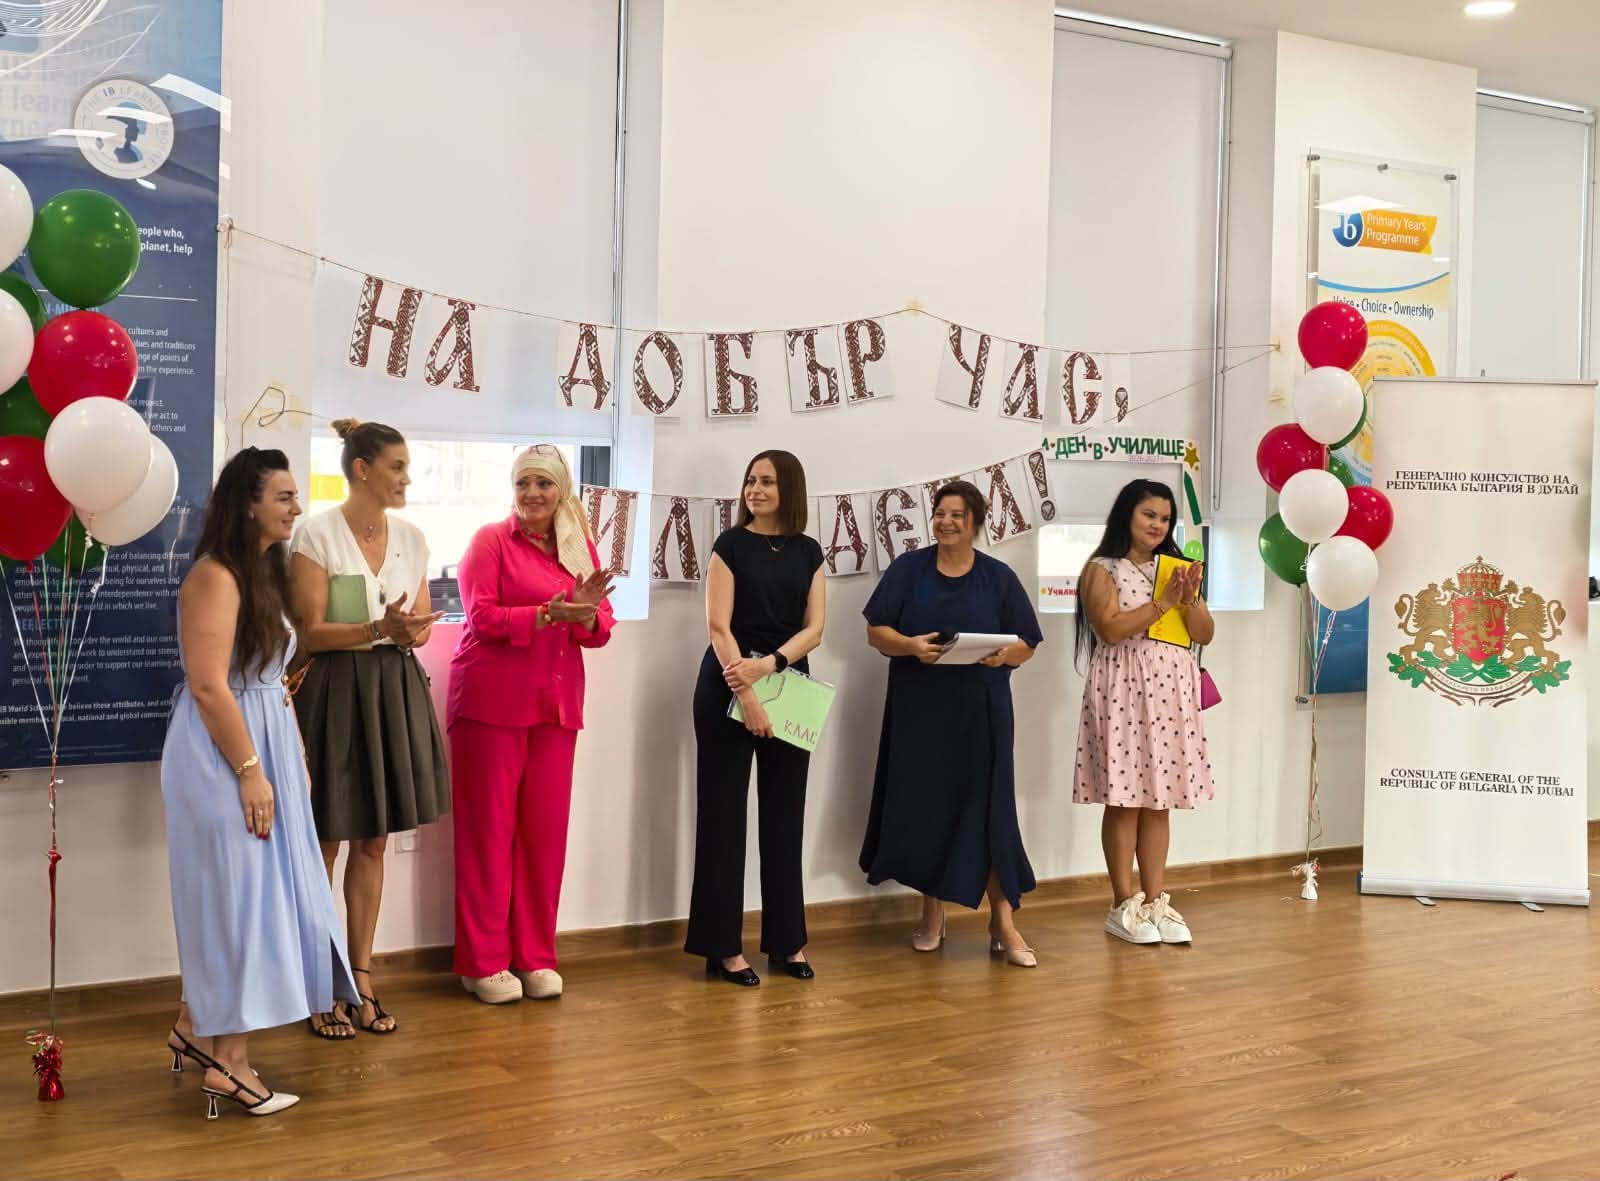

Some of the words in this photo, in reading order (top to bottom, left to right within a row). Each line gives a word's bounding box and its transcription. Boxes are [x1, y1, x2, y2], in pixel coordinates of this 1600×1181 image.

[1367, 213, 1401, 231] Primary
[1403, 219, 1426, 231] Years
[136, 226, 162, 238] eople
[163, 227, 185, 240] who,
[1366, 228, 1420, 245] Programme
[140, 241, 172, 253] planet,
[173, 243, 193, 256] help
[1361, 298, 1387, 313] Choice
[1393, 301, 1434, 320] Ownership
[127, 326, 154, 336] cultures
[155, 328, 169, 336] and
[151, 341, 163, 349] and
[164, 341, 196, 350] traditions
[349, 275, 480, 393] НА
[558, 318, 887, 415] ДОБЪР
[948, 322, 1129, 426] ЧАС,
[160, 354, 180, 362] points
[158, 366, 196, 376] experience.
[171, 411, 179, 420] to
[151, 424, 173, 433] others
[173, 424, 186, 433] and
[1055, 435, 1087, 459] ДЕН
[1093, 442, 1103, 460] В
[1108, 436, 1184, 460] УЧИЛИЩЕ
[1394, 470, 1467, 482] ГЕНЕРАЛНО
[1470, 472, 1549, 484] КОНСУЛСТВО
[1553, 475, 1570, 485] НА
[1386, 480, 1457, 492] РЕПУБЛИКА
[1461, 483, 1523, 494] БЪЛГАРИЯ
[1527, 484, 1535, 494] В
[1538, 484, 1579, 496] ДУБАЙ
[824, 451, 1055, 574] ДЕА!
[151, 564, 165, 572] and
[133, 635, 145, 643] and
[8, 704, 29, 713] World
[1390, 768, 1457, 781] CONSULATE
[1460, 771, 1515, 784] GENERAL
[1518, 774, 1534, 785] OF
[1536, 776, 1560, 786] THE
[1380, 777, 1438, 790] REPUBLIC
[1440, 780, 1456, 791] OF
[1459, 782, 1518, 795] BULGARIA
[1521, 785, 1534, 795] IN
[1536, 786, 1575, 797] DUBAI
